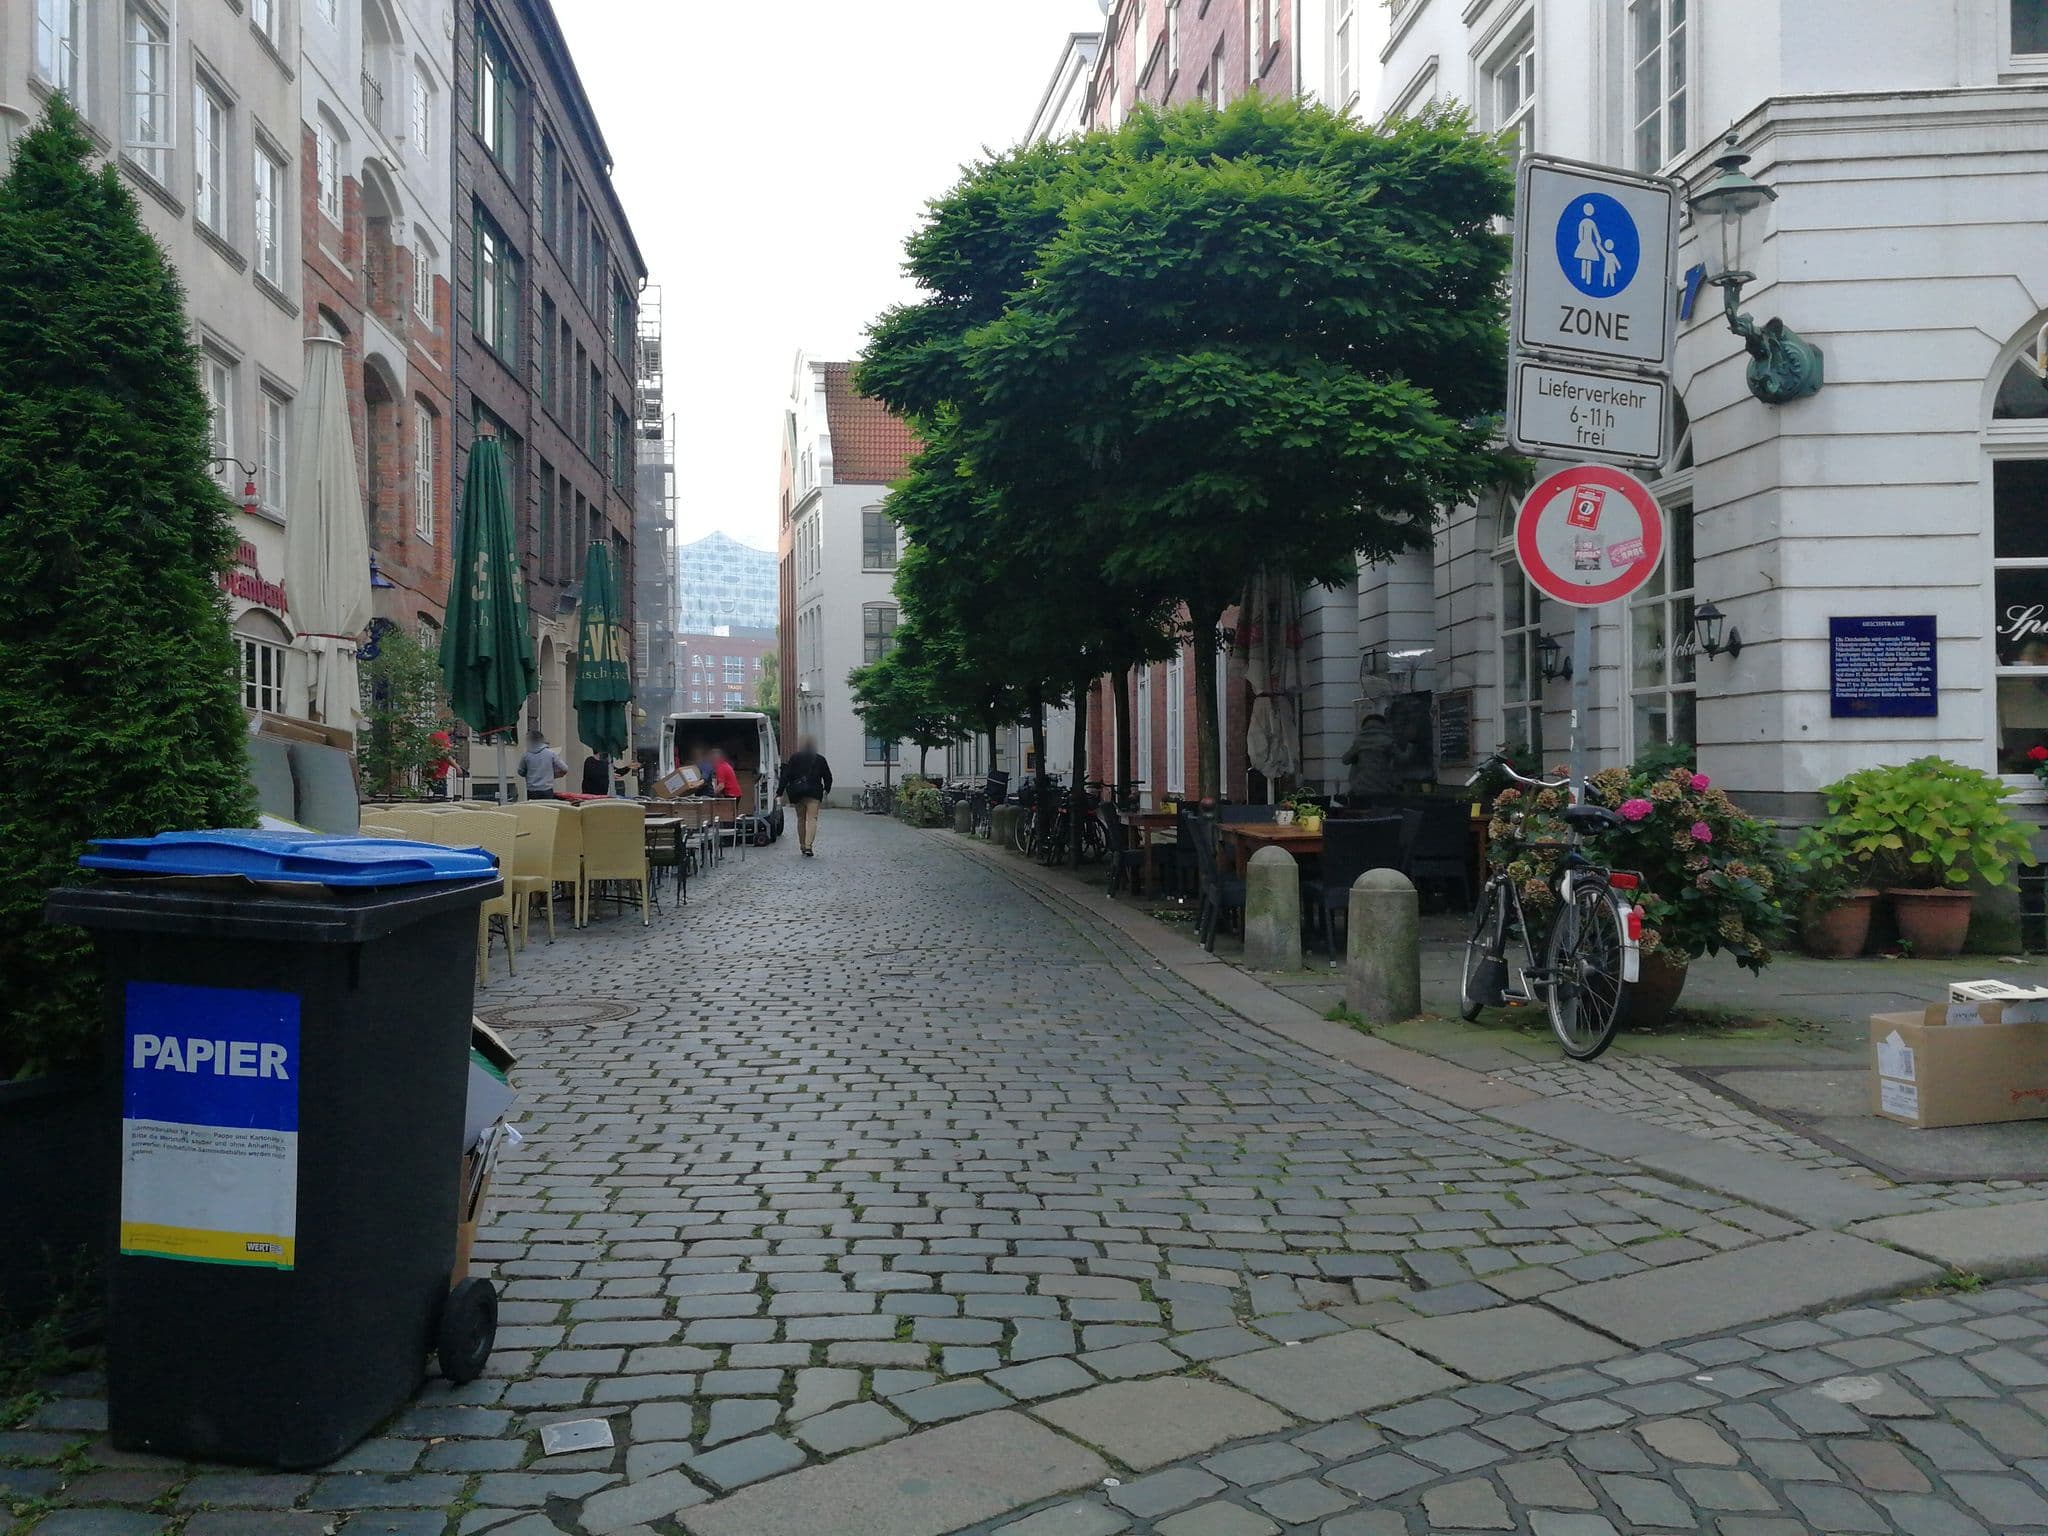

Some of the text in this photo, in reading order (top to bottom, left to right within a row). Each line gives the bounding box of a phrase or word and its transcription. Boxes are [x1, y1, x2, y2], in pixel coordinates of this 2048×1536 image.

[1559, 305, 1630, 342] ZONE
[1538, 377, 1647, 409] Lieferverkehr
[1576, 425, 1606, 447] frei
[133, 1034, 290, 1080] PAPIER
[247, 1242, 270, 1253] WERT
